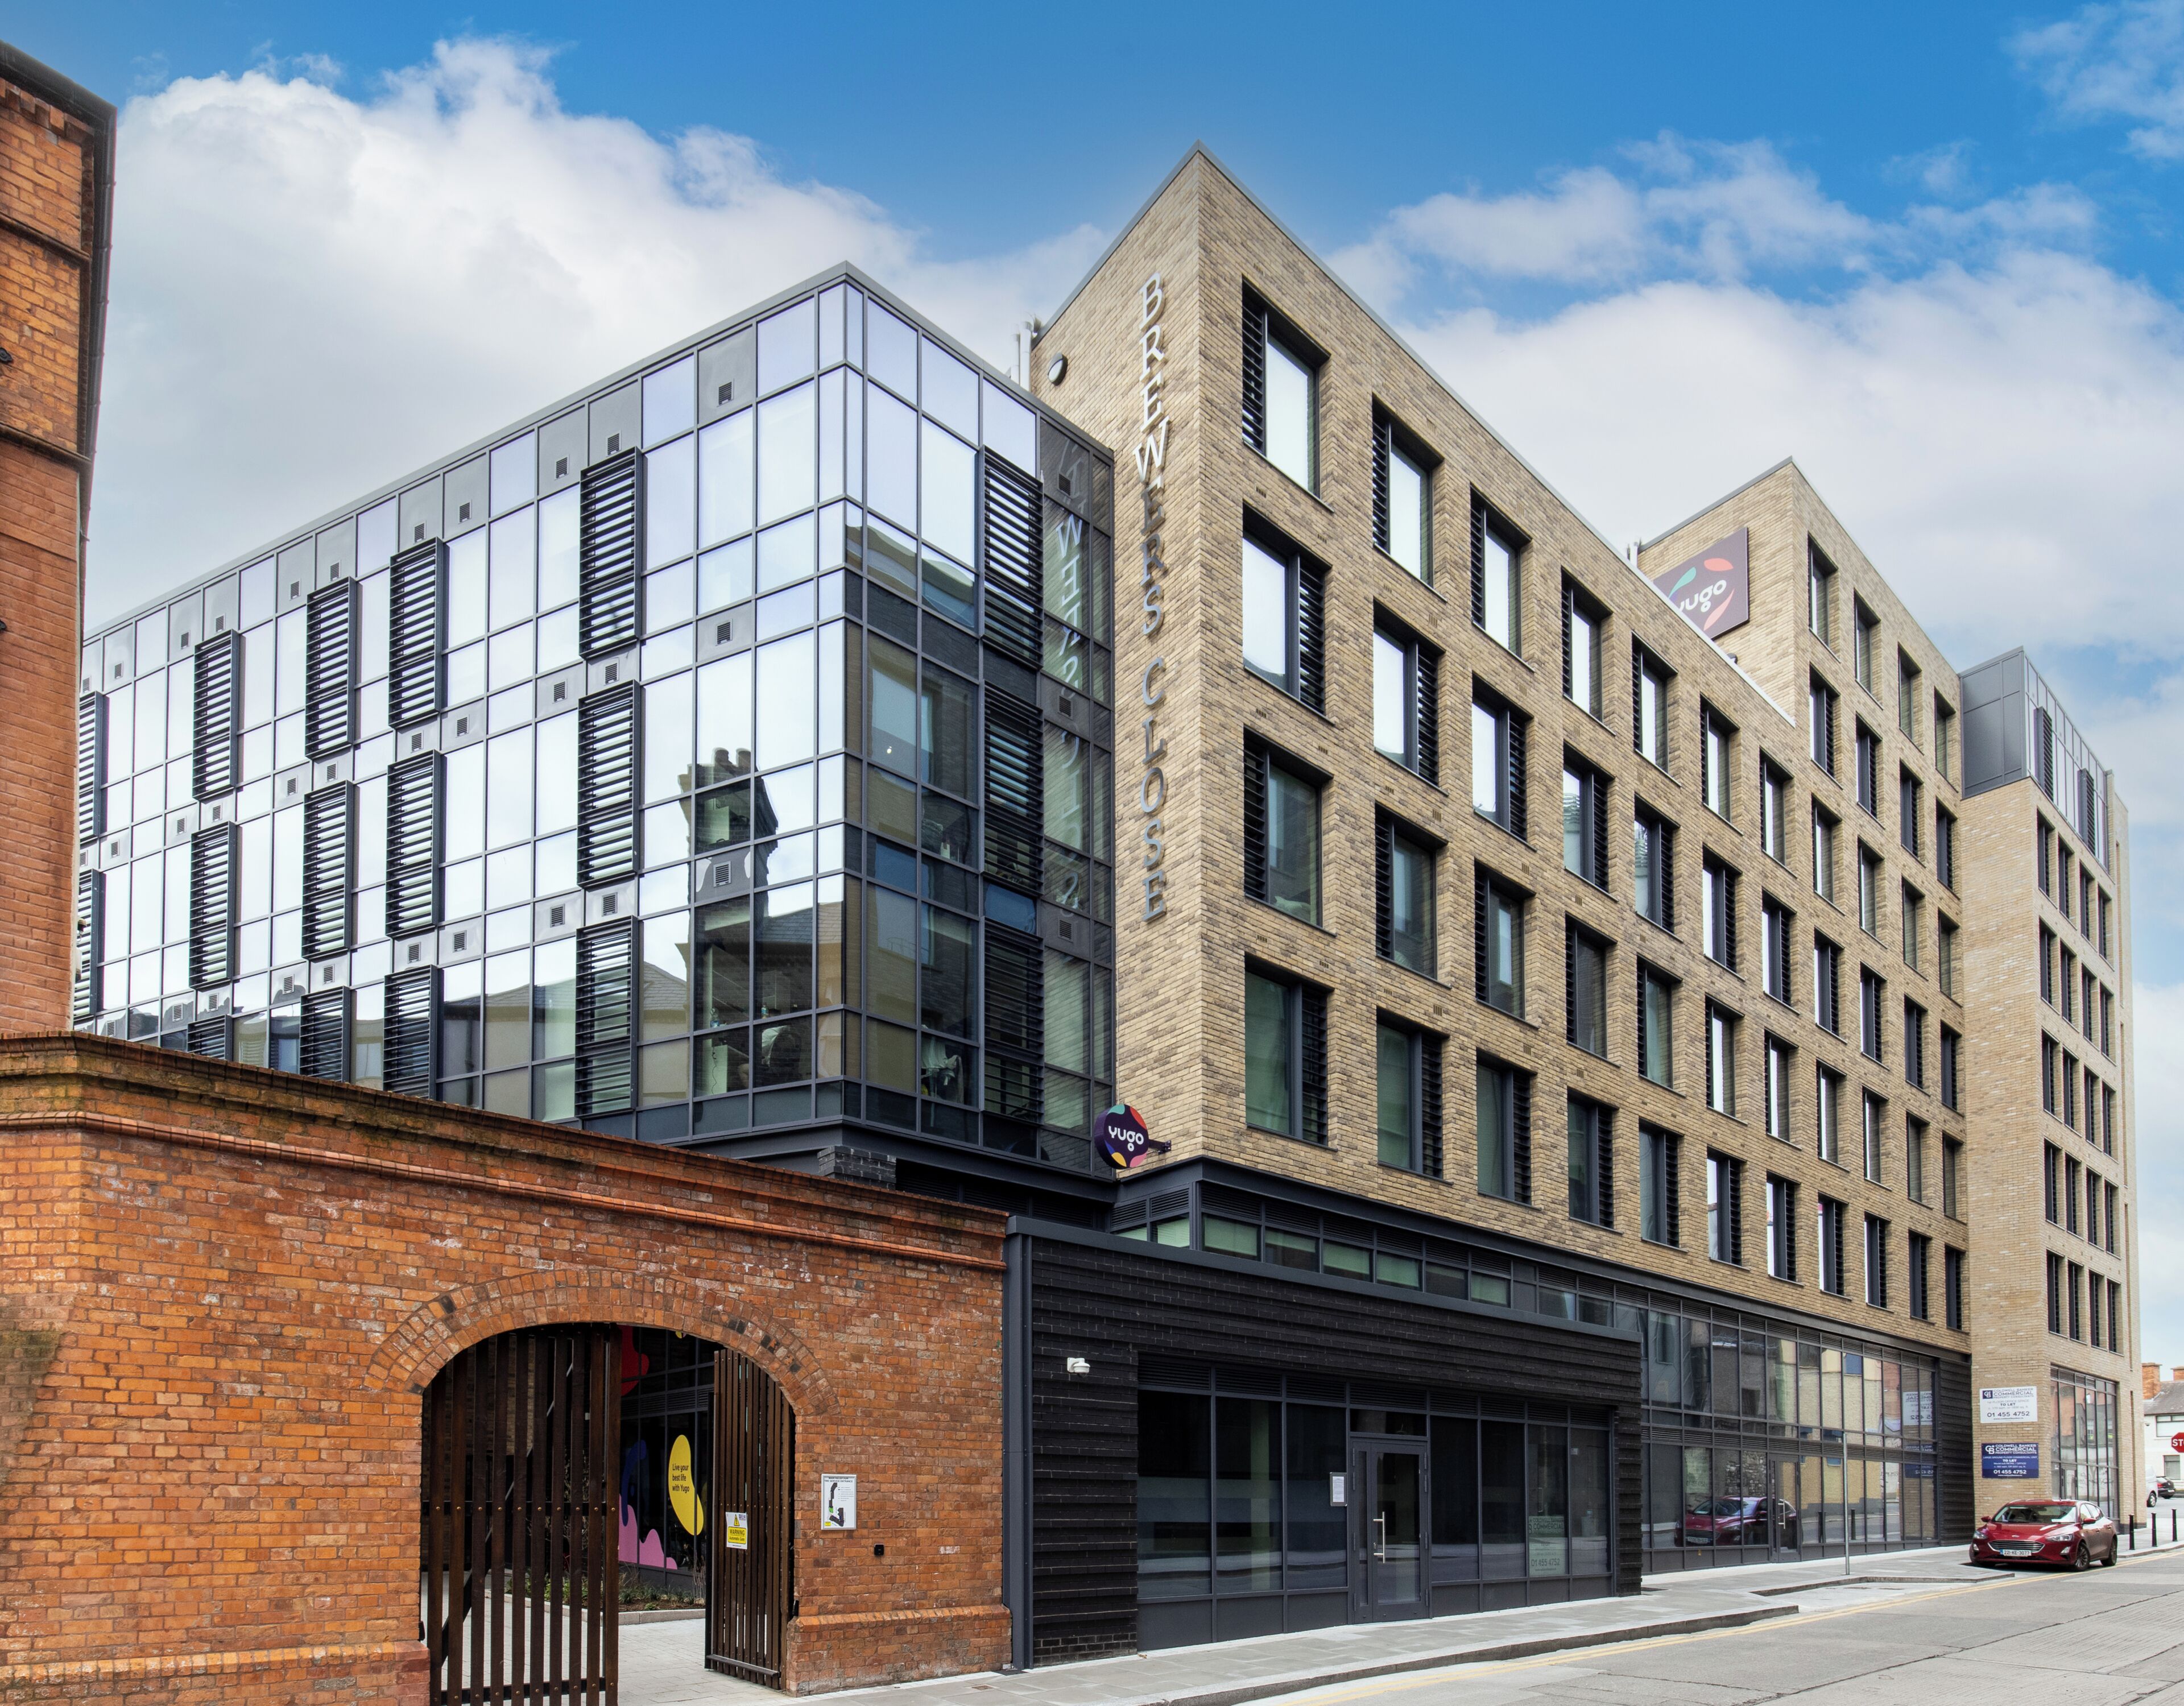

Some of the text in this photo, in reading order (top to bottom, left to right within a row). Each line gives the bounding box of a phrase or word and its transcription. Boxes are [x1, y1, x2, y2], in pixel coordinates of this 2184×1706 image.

[1133, 272, 1172, 922] BREWERS CLOSE
[1108, 1125, 1144, 1152] yugo
[680, 1484, 689, 1493] Yugo
